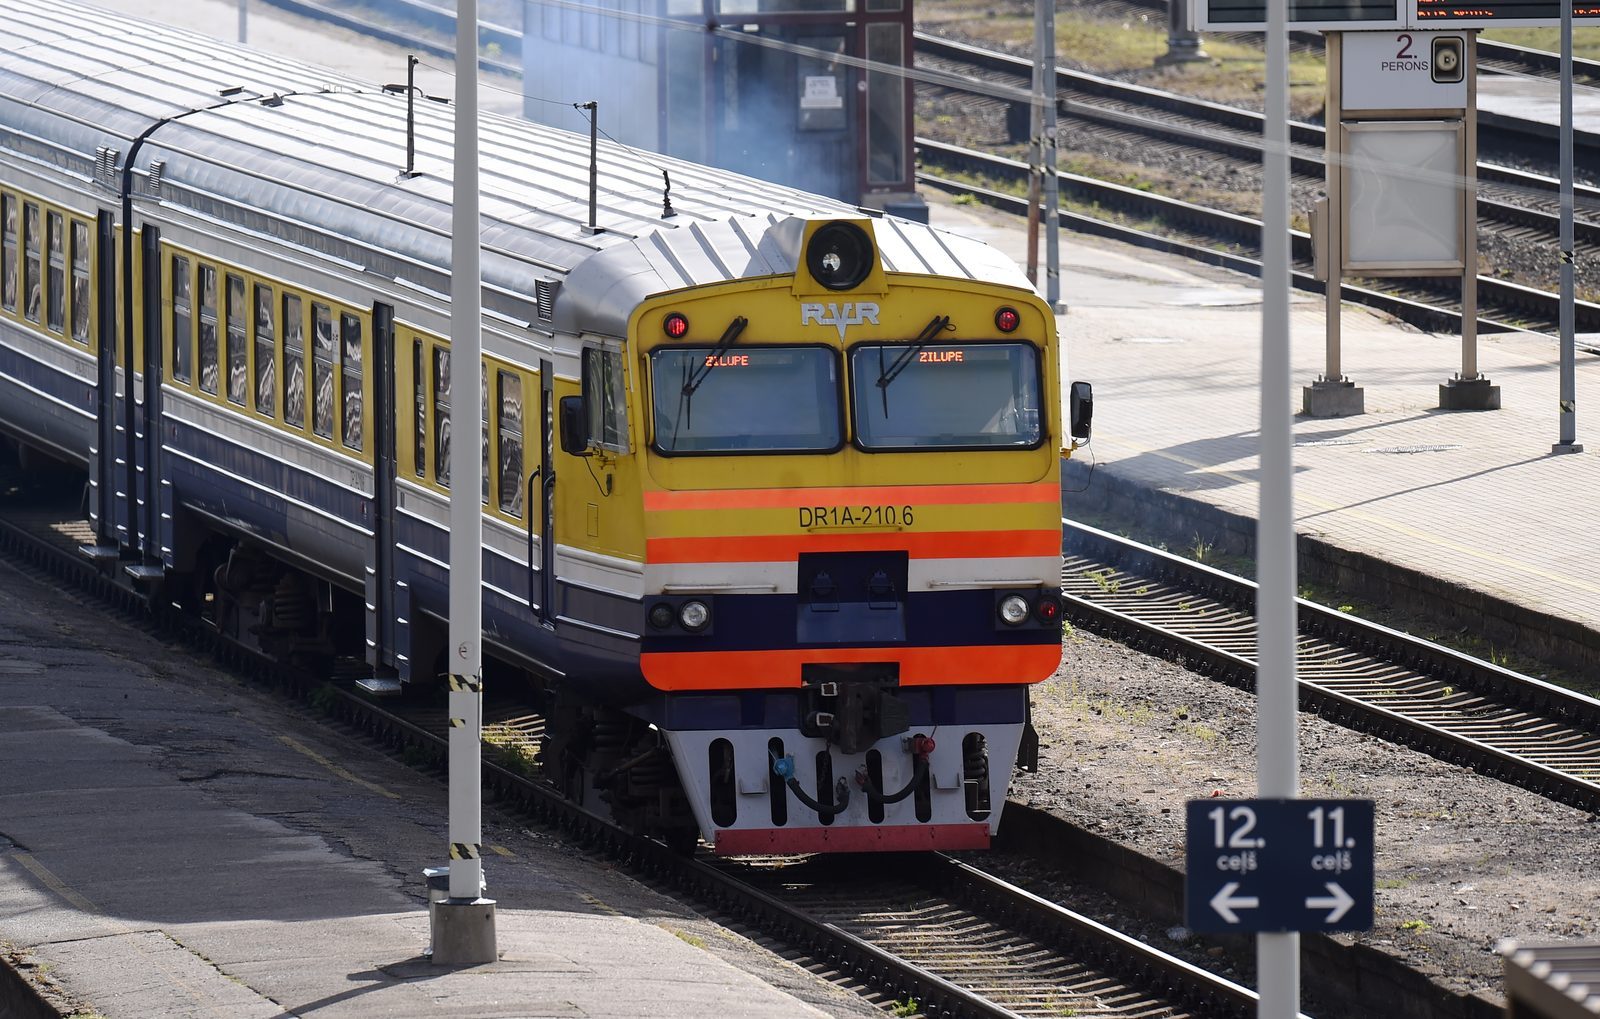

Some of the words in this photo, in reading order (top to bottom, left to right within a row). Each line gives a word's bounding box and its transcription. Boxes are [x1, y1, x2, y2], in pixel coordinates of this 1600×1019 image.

[1396, 34, 1418, 59] 2.
[1381, 61, 1429, 71] PERONS
[801, 303, 880, 343] RVR
[919, 351, 963, 363] ZILUPE
[799, 505, 914, 527] DR1A-210.6
[1208, 806, 1266, 848] 12.
[1307, 806, 1356, 848] 11.
[1216, 850, 1258, 875] ceļš
[1311, 850, 1352, 875] ceļš
